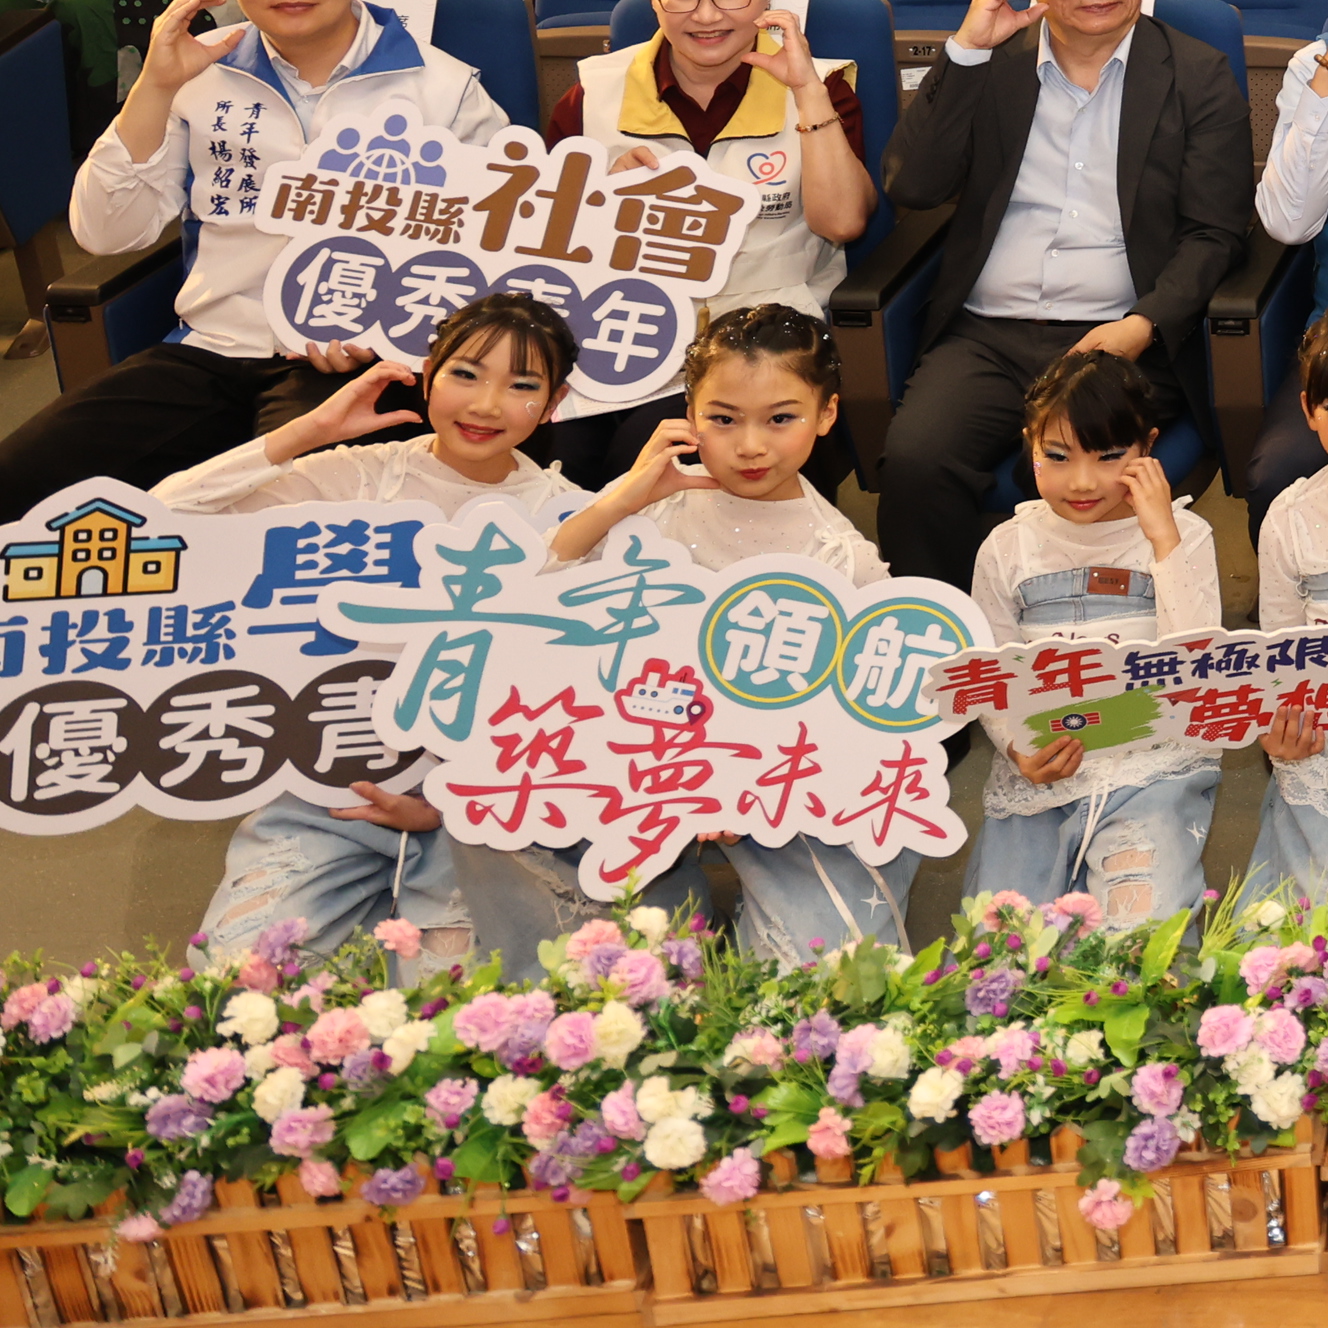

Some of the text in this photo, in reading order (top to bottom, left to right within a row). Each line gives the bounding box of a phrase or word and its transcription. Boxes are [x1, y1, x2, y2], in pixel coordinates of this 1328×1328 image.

[208, 99, 234, 218] 所長 楊紹宏
[237, 102, 269, 218] 青年發展所
